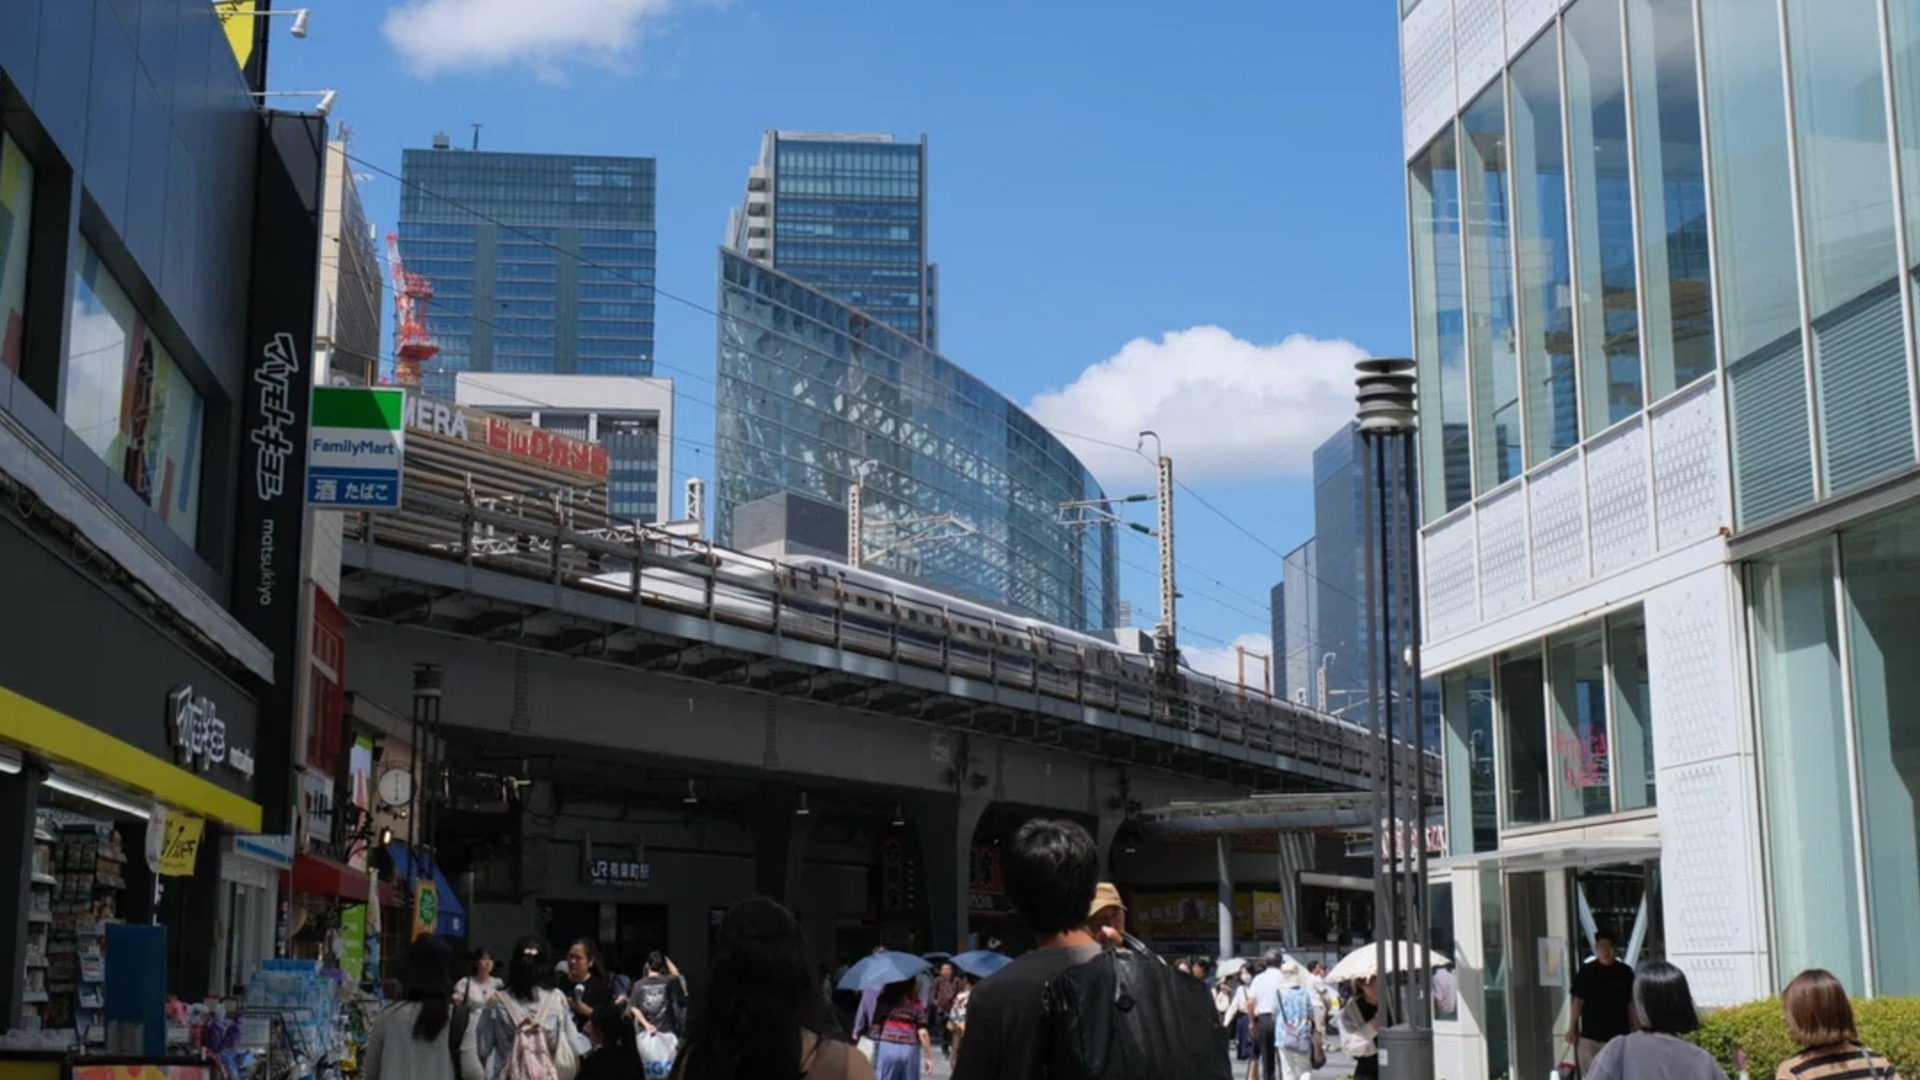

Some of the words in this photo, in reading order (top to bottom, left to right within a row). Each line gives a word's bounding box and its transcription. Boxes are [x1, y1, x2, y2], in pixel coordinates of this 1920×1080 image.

[252, 332, 299, 501] マツモトキヨシ
[313, 438, 395, 456] FamilyMart
[315, 479, 338, 501] 酒
[345, 482, 388, 501] たばこ
[257, 518, 275, 605] matsukiyo
